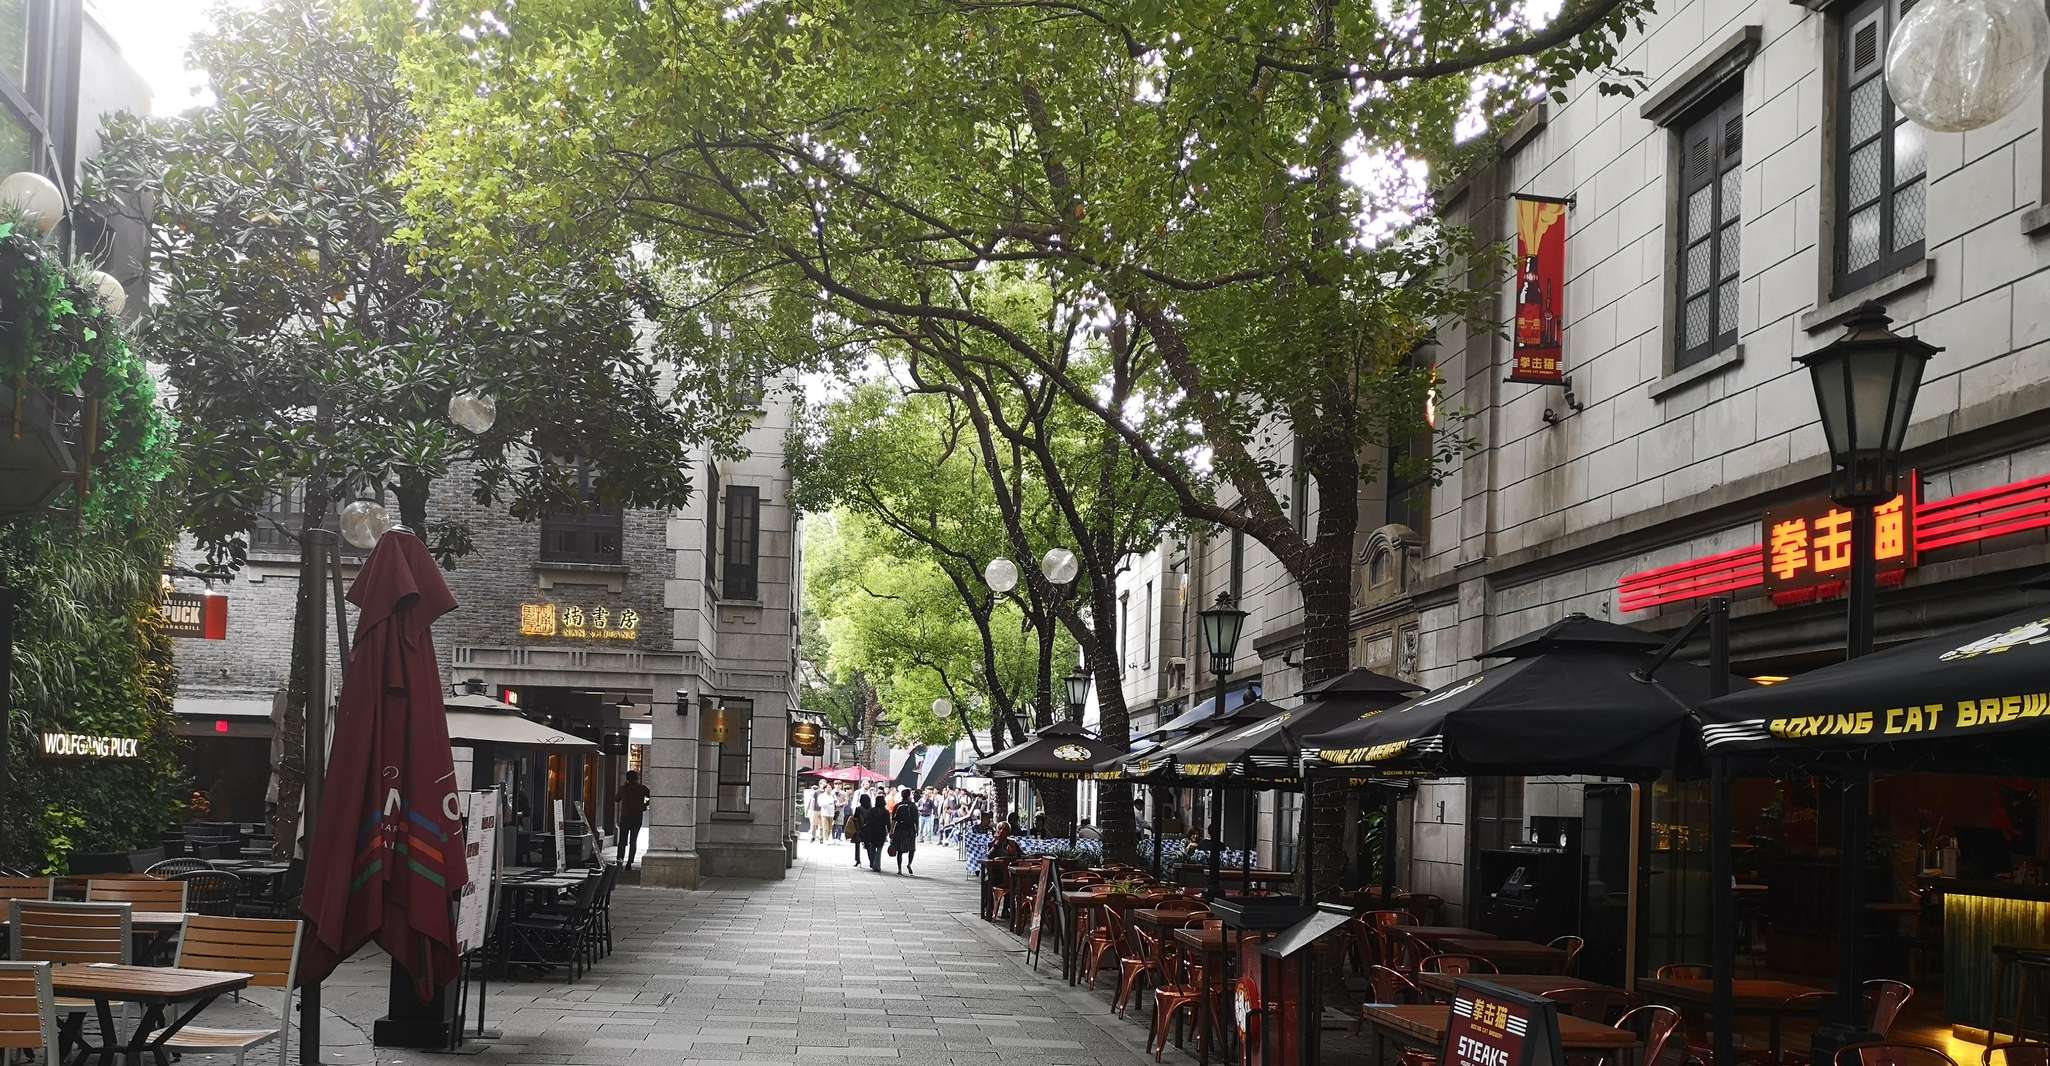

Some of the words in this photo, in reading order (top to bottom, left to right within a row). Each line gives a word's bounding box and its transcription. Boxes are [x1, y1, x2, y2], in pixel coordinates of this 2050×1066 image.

[1520, 356, 1554, 369] 拳击猫
[161, 605, 200, 623] PUCK
[1770, 712, 1873, 738] BOXING
[1884, 704, 1943, 734] CAT
[1956, 692, 2050, 728] BREW
[44, 733, 110, 757] WOLFGANG
[110, 737, 138, 757] PUCK
[1472, 998, 1508, 1029] 拳击猫
[1457, 1035, 1509, 1066] STEAKS
